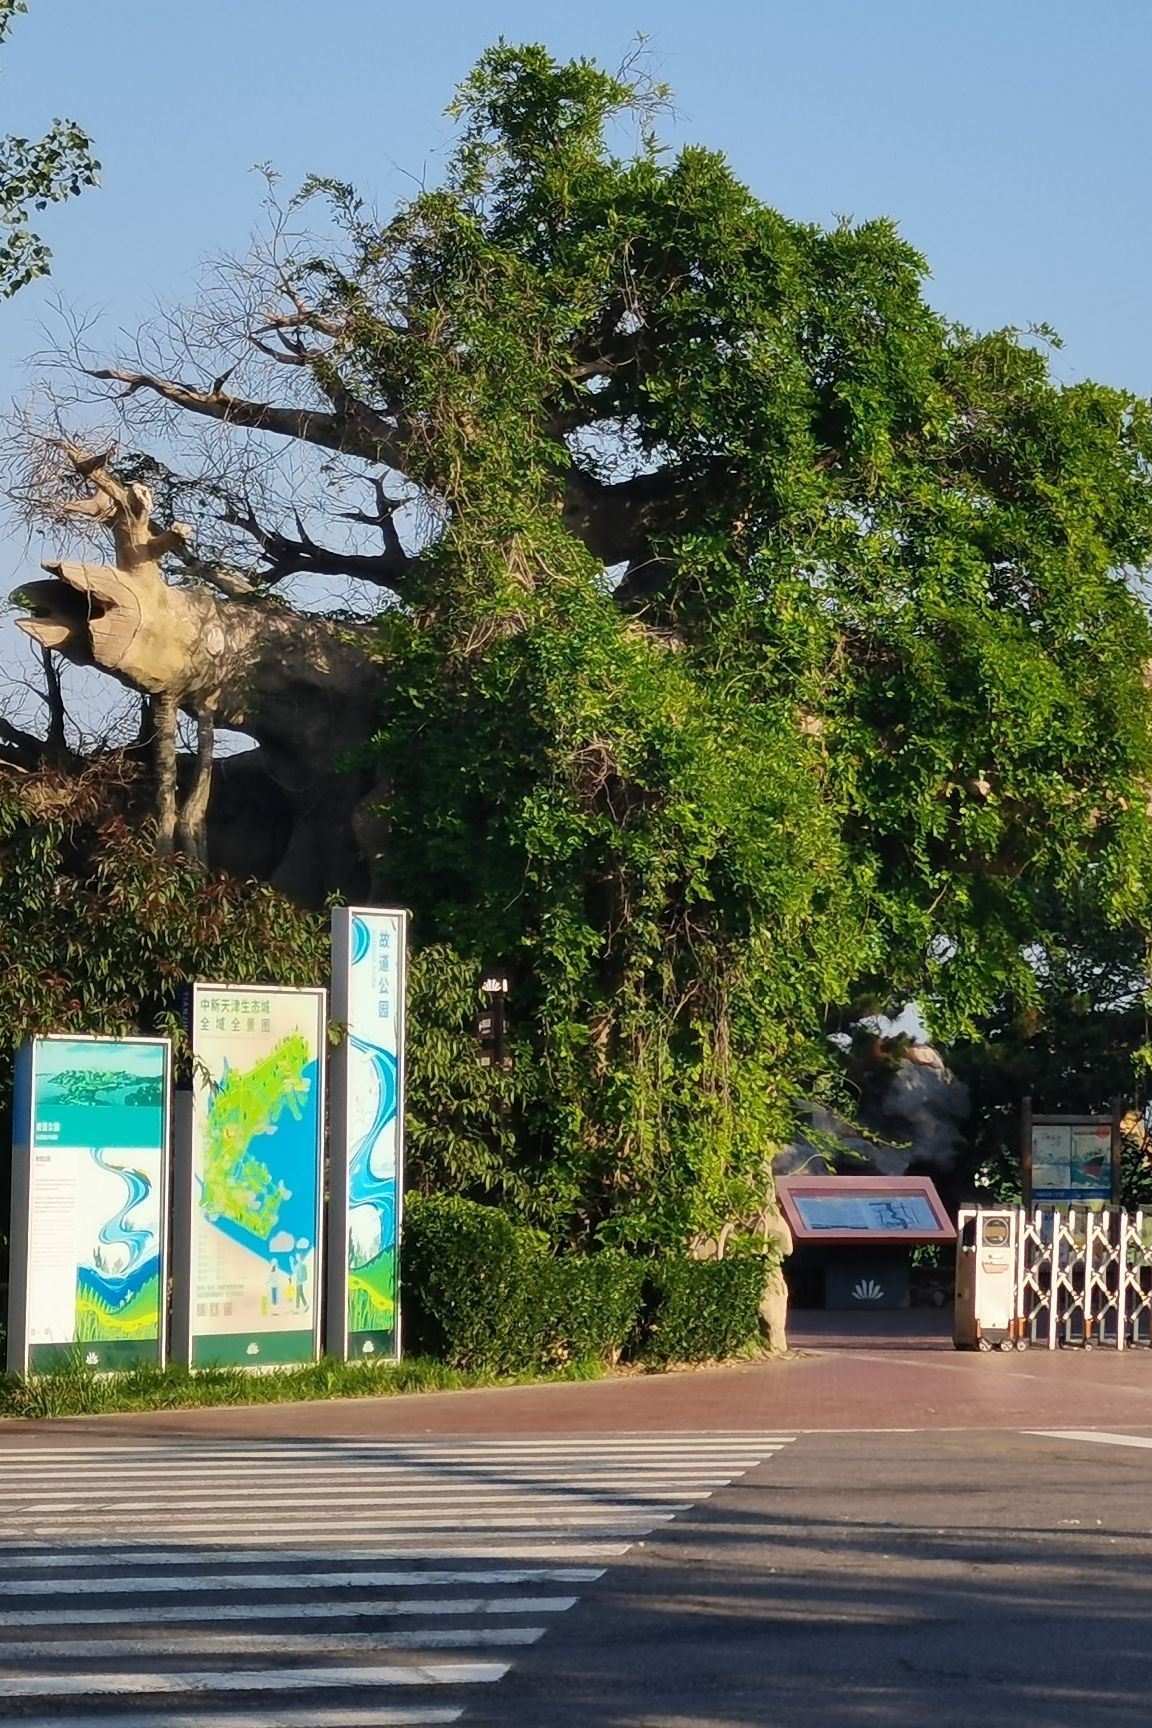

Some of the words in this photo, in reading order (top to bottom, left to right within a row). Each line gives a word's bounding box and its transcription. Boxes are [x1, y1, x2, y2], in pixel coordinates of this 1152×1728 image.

[378, 930, 390, 1018] 故道公园
[200, 998, 270, 1014] 中新天津生态城
